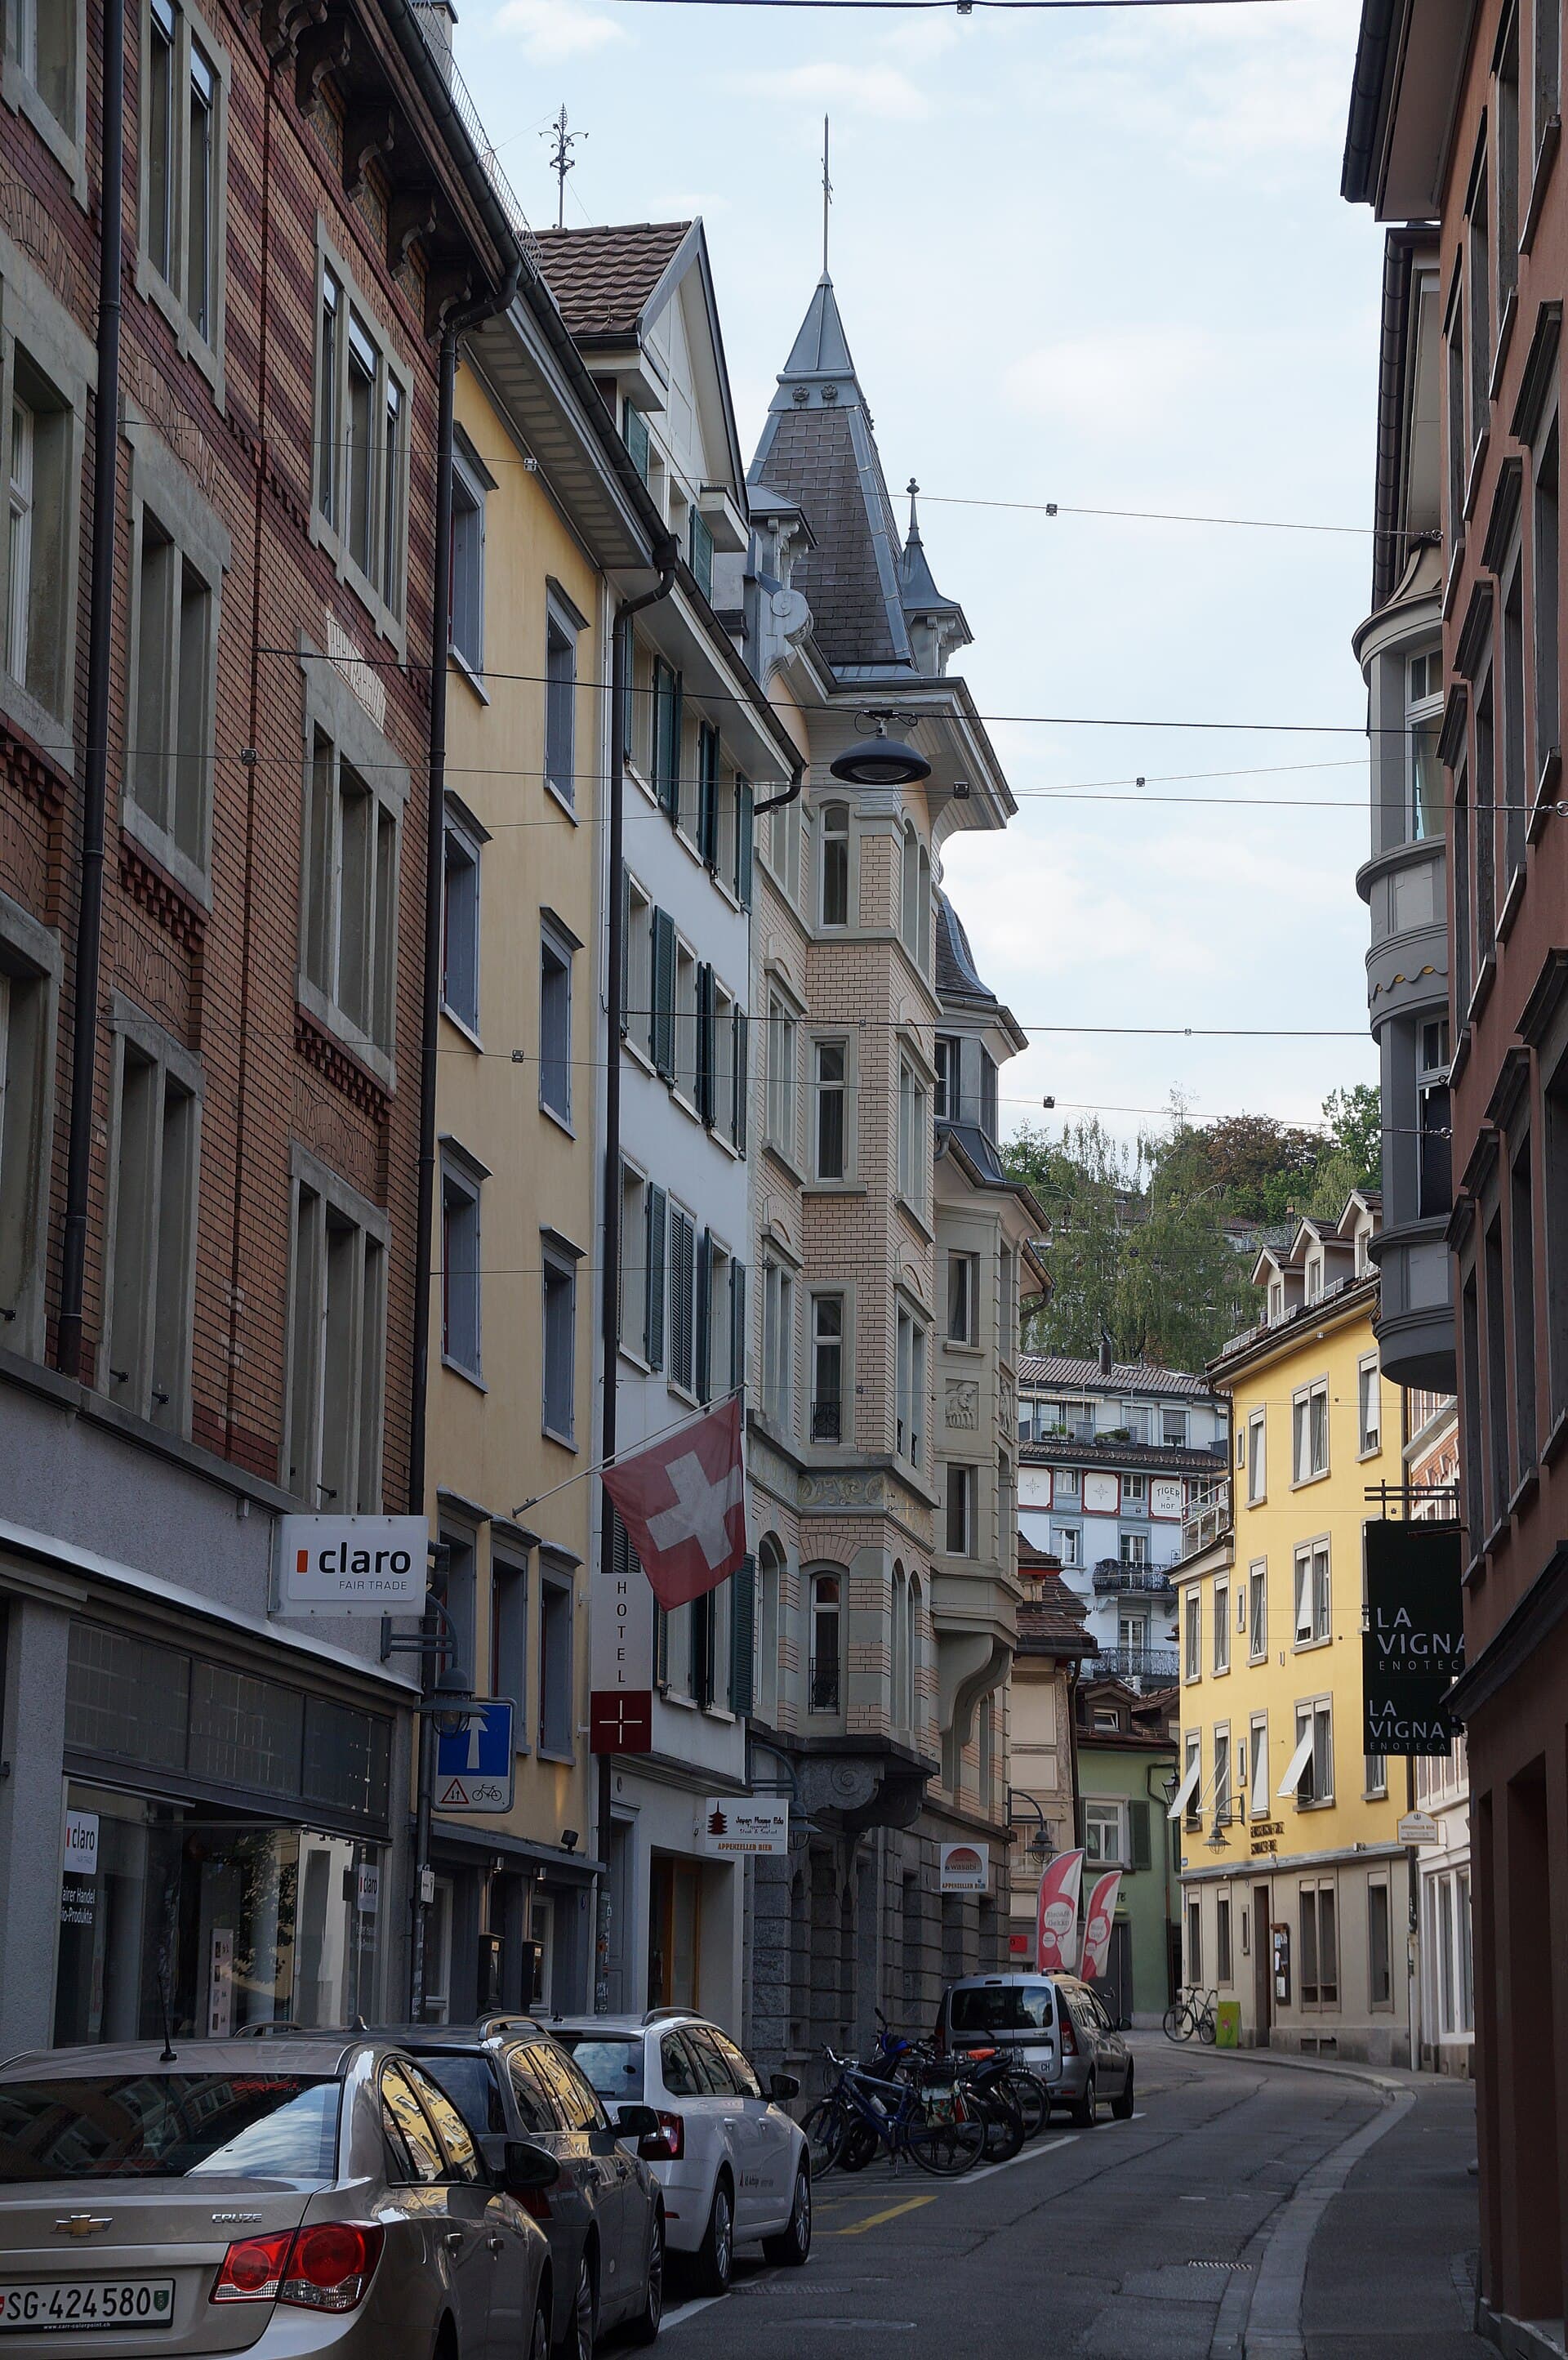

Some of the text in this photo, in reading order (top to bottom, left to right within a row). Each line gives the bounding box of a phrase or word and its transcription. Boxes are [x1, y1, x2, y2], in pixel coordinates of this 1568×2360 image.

[1157, 1487, 1180, 1498] TIGER
[318, 1541, 412, 1574] claro
[339, 1581, 408, 1590] FAIR TRADE
[1377, 1608, 1412, 1628] LA
[617, 1581, 627, 1683] HOTEL
[1379, 1660, 1459, 1671] ENOTEC
[1369, 1700, 1396, 1716] LA
[1369, 1721, 1446, 1739] VIGNA
[1370, 1742, 1446, 1751] ENOTECA
[73, 1821, 96, 1851] claro
[364, 1871, 378, 1894] claro
[77, 1888, 95, 1904] Handel
[1041, 2063, 1050, 2072] CH
[212, 2213, 262, 2223] CRUZE
